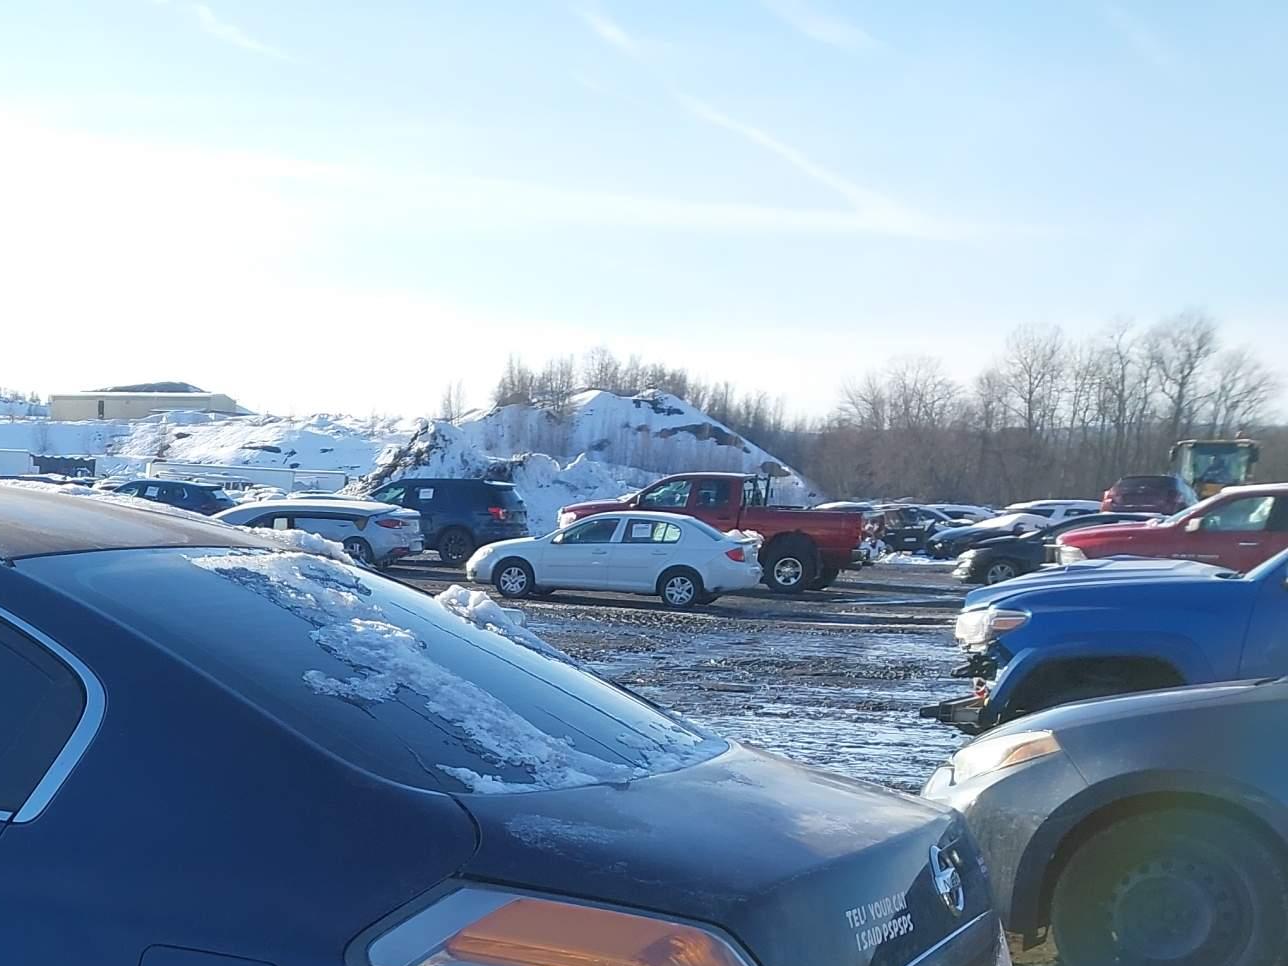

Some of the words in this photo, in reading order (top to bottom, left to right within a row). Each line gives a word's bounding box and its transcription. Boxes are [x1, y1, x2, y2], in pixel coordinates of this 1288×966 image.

[868, 896, 894, 920] YOUR
[892, 891, 908, 912] CAT
[855, 933, 862, 952] I
[861, 926, 882, 950] SAID
[882, 913, 914, 942] PSPSPS
